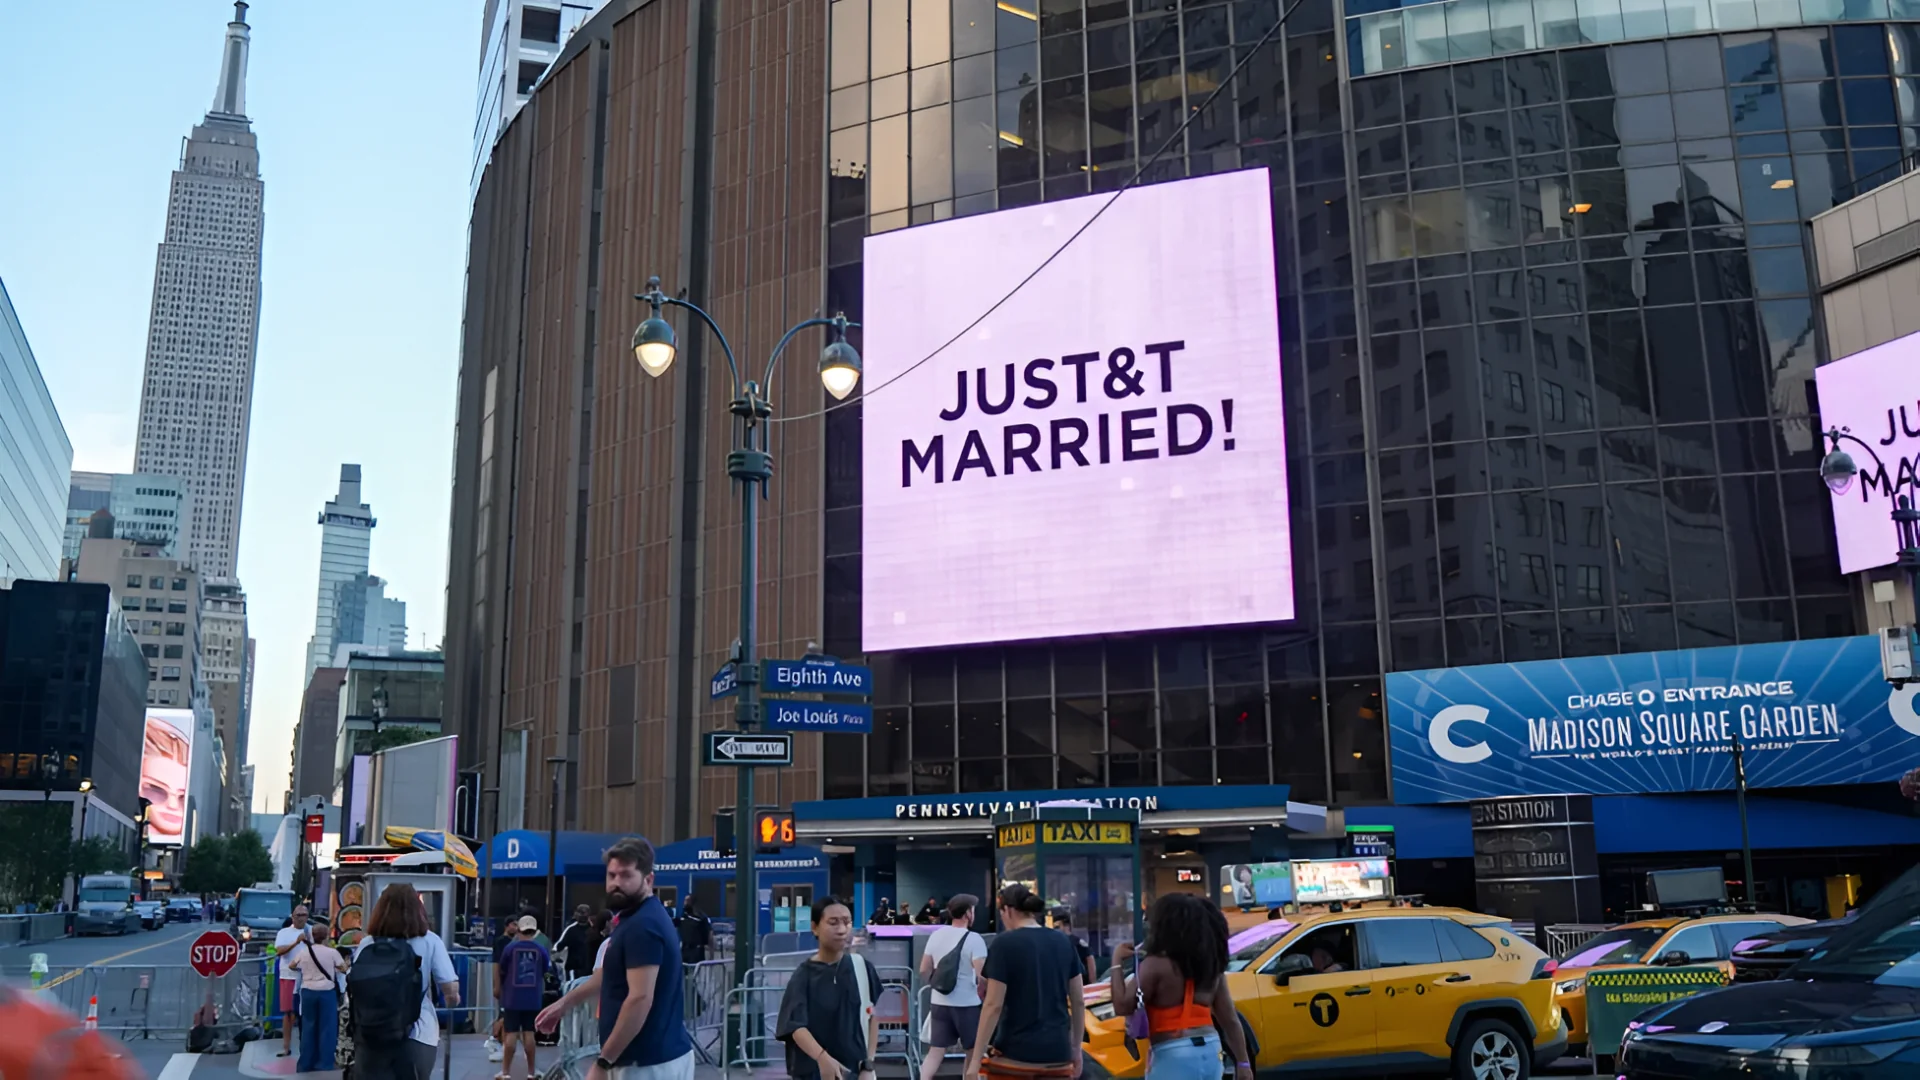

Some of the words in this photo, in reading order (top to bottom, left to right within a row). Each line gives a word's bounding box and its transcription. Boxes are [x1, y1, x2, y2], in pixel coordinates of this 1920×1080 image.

[939, 340, 1185, 421] JUST&T
[902, 398, 1236, 487] MARRIED!
[778, 667, 827, 687] Eighth
[833, 671, 862, 687] Ave
[1567, 691, 1633, 709] CHASE
[1663, 680, 1794, 703] ENTRANCE
[777, 707, 800, 723] Joe
[804, 708, 838, 725] Louis
[1527, 717, 1632, 752] MADISON
[1640, 709, 1732, 745] SQUARE
[1047, 823, 1101, 841] TAXI
[508, 838, 519, 858] D
[193, 945, 236, 963] STOP
